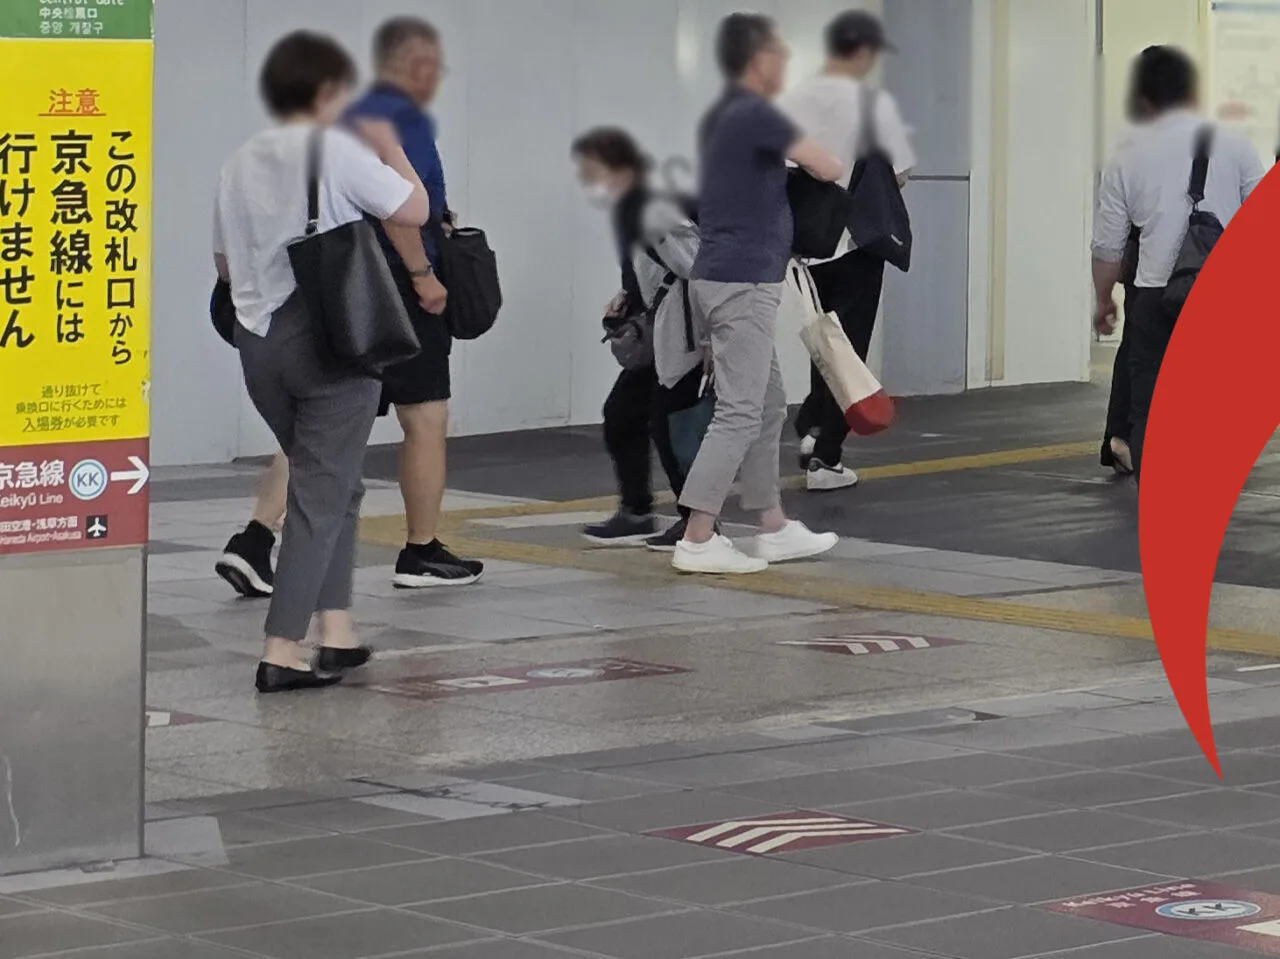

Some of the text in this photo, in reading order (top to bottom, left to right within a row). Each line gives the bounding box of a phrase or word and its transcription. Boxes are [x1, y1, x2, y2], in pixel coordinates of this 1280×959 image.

[49, 88, 101, 113] 注意
[0, 132, 38, 349] 行けません
[50, 129, 93, 344] 京急線には
[105, 130, 139, 365] この改札口から
[41, 383, 101, 399] 通り抜けて
[22, 414, 120, 433] 入場券が必要です
[0, 458, 65, 490] 京急線
[76, 471, 99, 488] KK
[40, 493, 64, 505] Line
